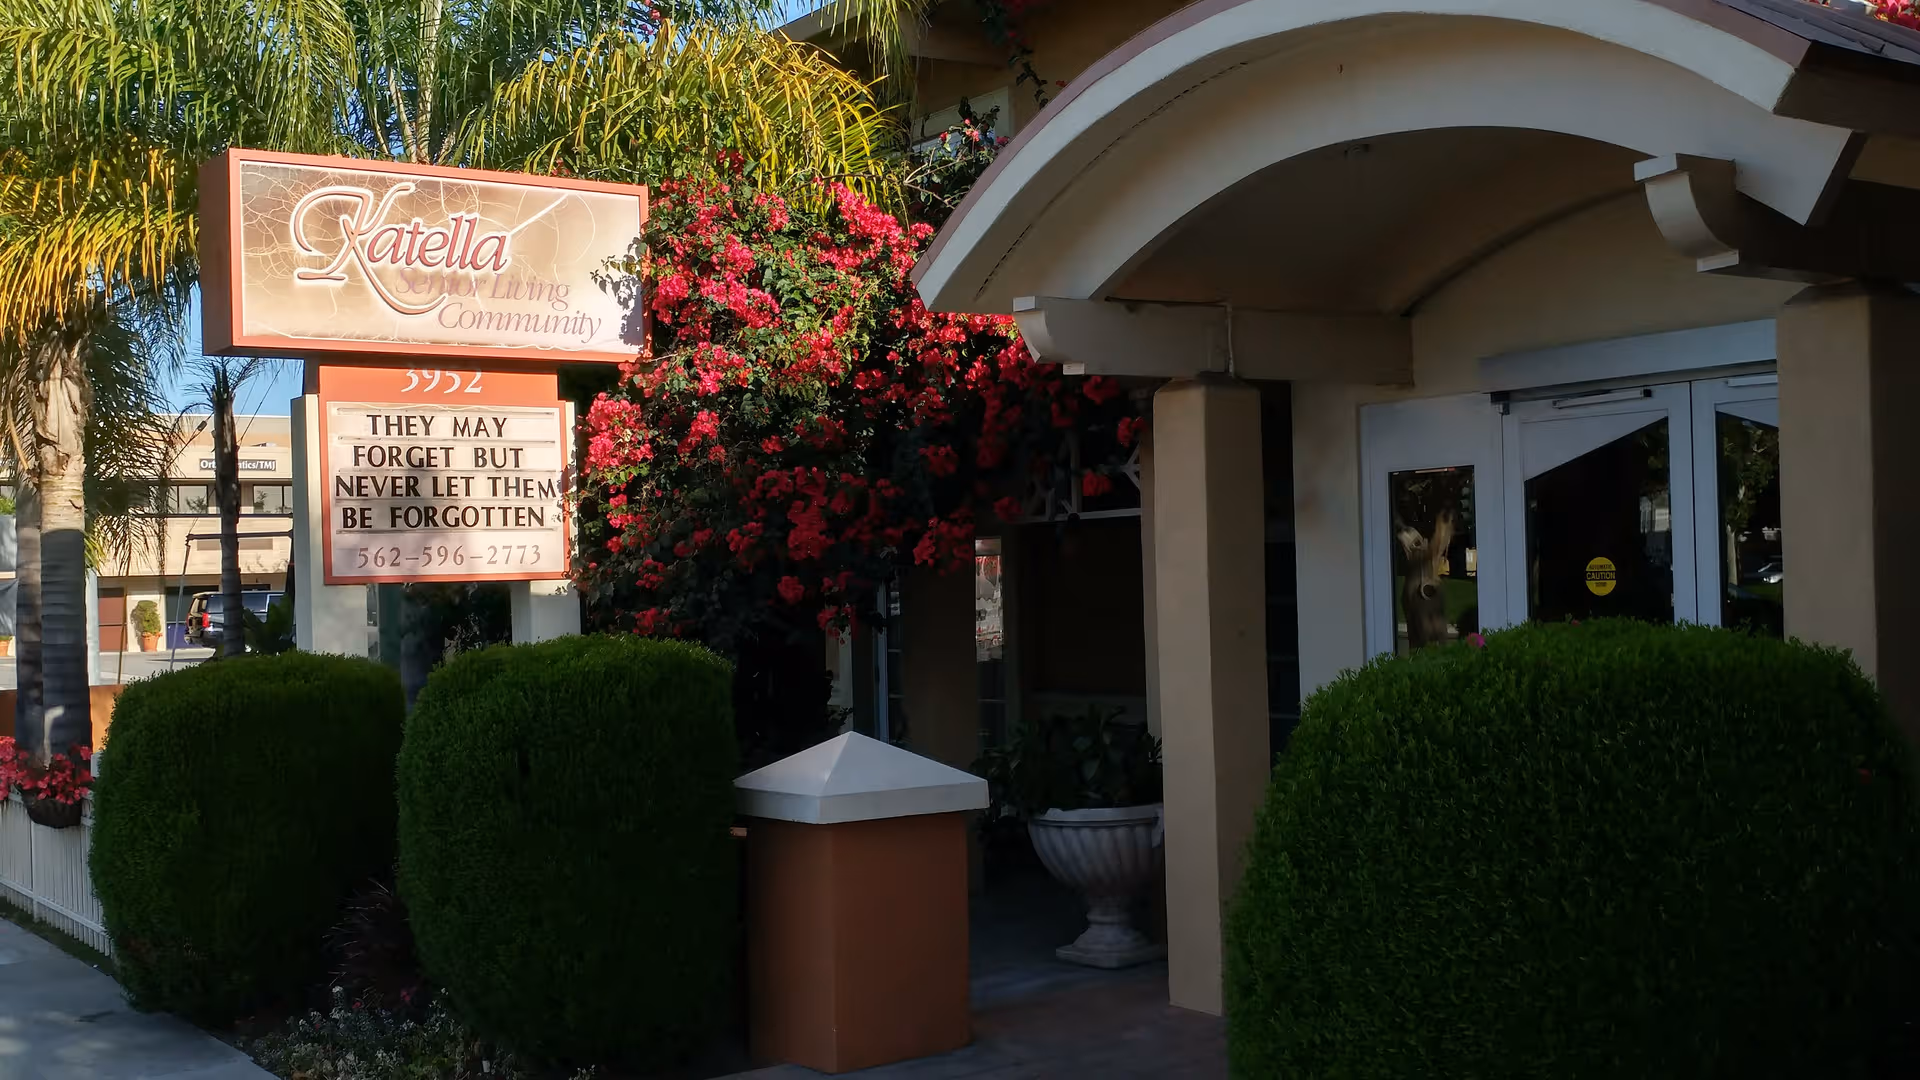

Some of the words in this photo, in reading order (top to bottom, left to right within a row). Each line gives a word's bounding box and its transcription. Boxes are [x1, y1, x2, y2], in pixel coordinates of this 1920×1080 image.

[293, 183, 509, 315] Katella
[396, 267, 487, 297] Senior
[488, 273, 572, 312] Living
[437, 301, 602, 344] Community
[401, 368, 483, 394] 3952
[366, 414, 435, 437] THEY
[452, 416, 508, 438] MAY
[353, 445, 455, 468] FORGET
[473, 447, 524, 469] BUT
[335, 475, 421, 498] NEVER
[432, 476, 475, 498] LET
[487, 476, 557, 501] THEM
[342, 507, 373, 529] BE
[390, 506, 545, 529] FORGOTTEN
[357, 544, 541, 569] 562-596-2773
[1586, 571, 1616, 580] CAUTION
